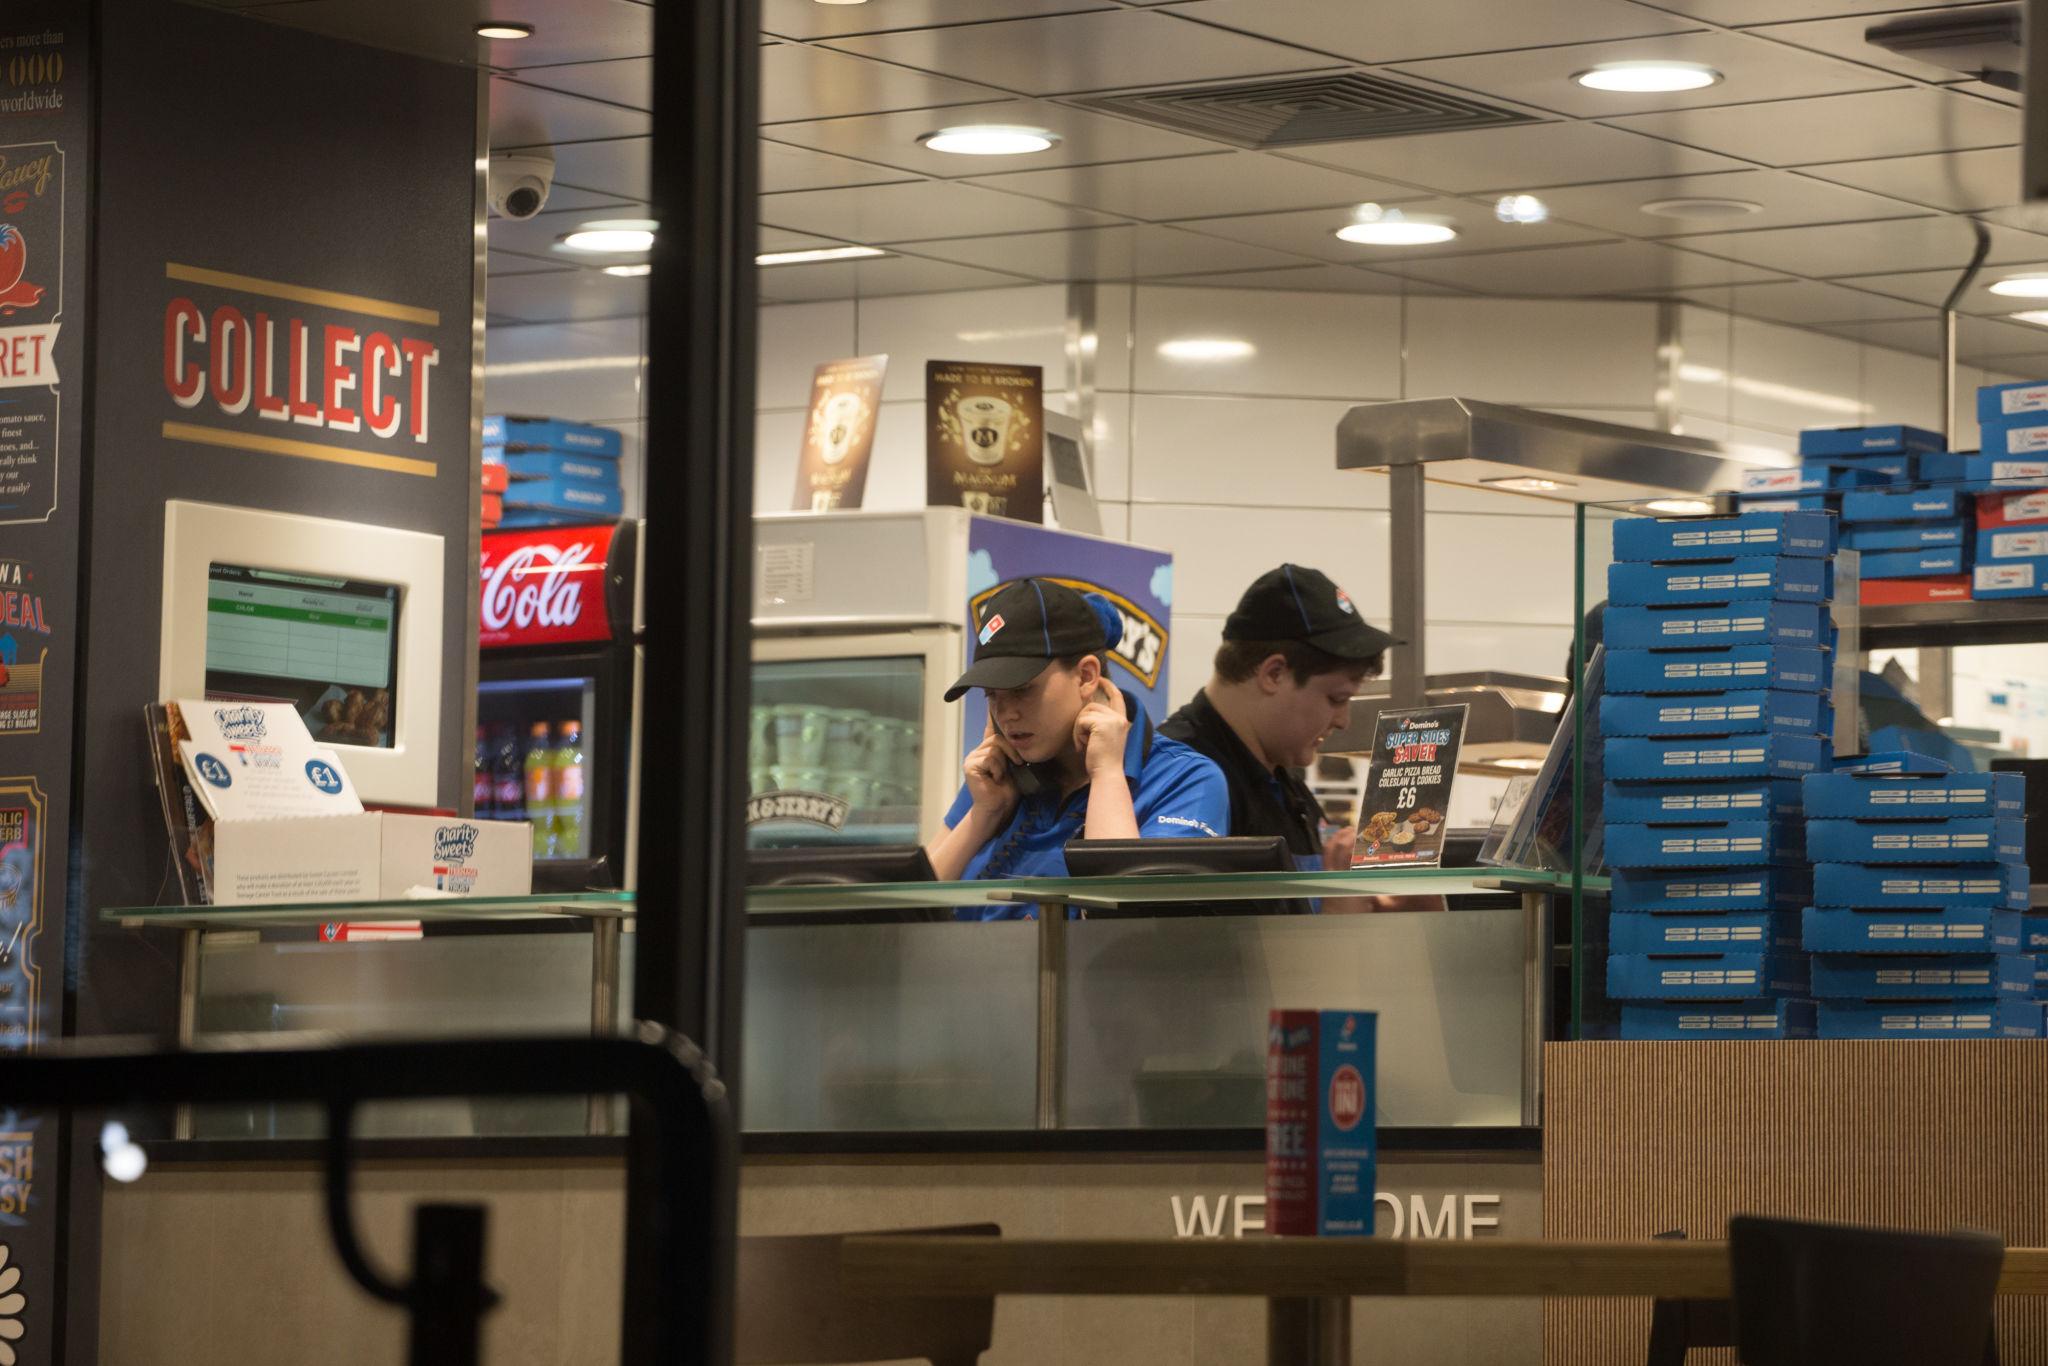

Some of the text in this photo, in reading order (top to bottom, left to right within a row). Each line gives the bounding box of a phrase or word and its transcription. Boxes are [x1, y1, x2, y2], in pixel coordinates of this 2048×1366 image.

[163, 296, 440, 444] COLLECT
[1409, 719, 1439, 730] Domino's
[1386, 729, 1450, 749] SUPER SIDES
[1393, 744, 1437, 764] SAVER
[200, 759, 228, 781] £1
[311, 767, 339, 788] £1
[1382, 765, 1442, 779] GARLIC PIZZA BREAD
[1379, 774, 1442, 788] COLESLAW & COOKIES
[1397, 787, 1417, 809] £6
[1158, 815, 1200, 829] Domino's
[435, 823, 479, 844] Charity
[433, 841, 474, 860] Sweets
